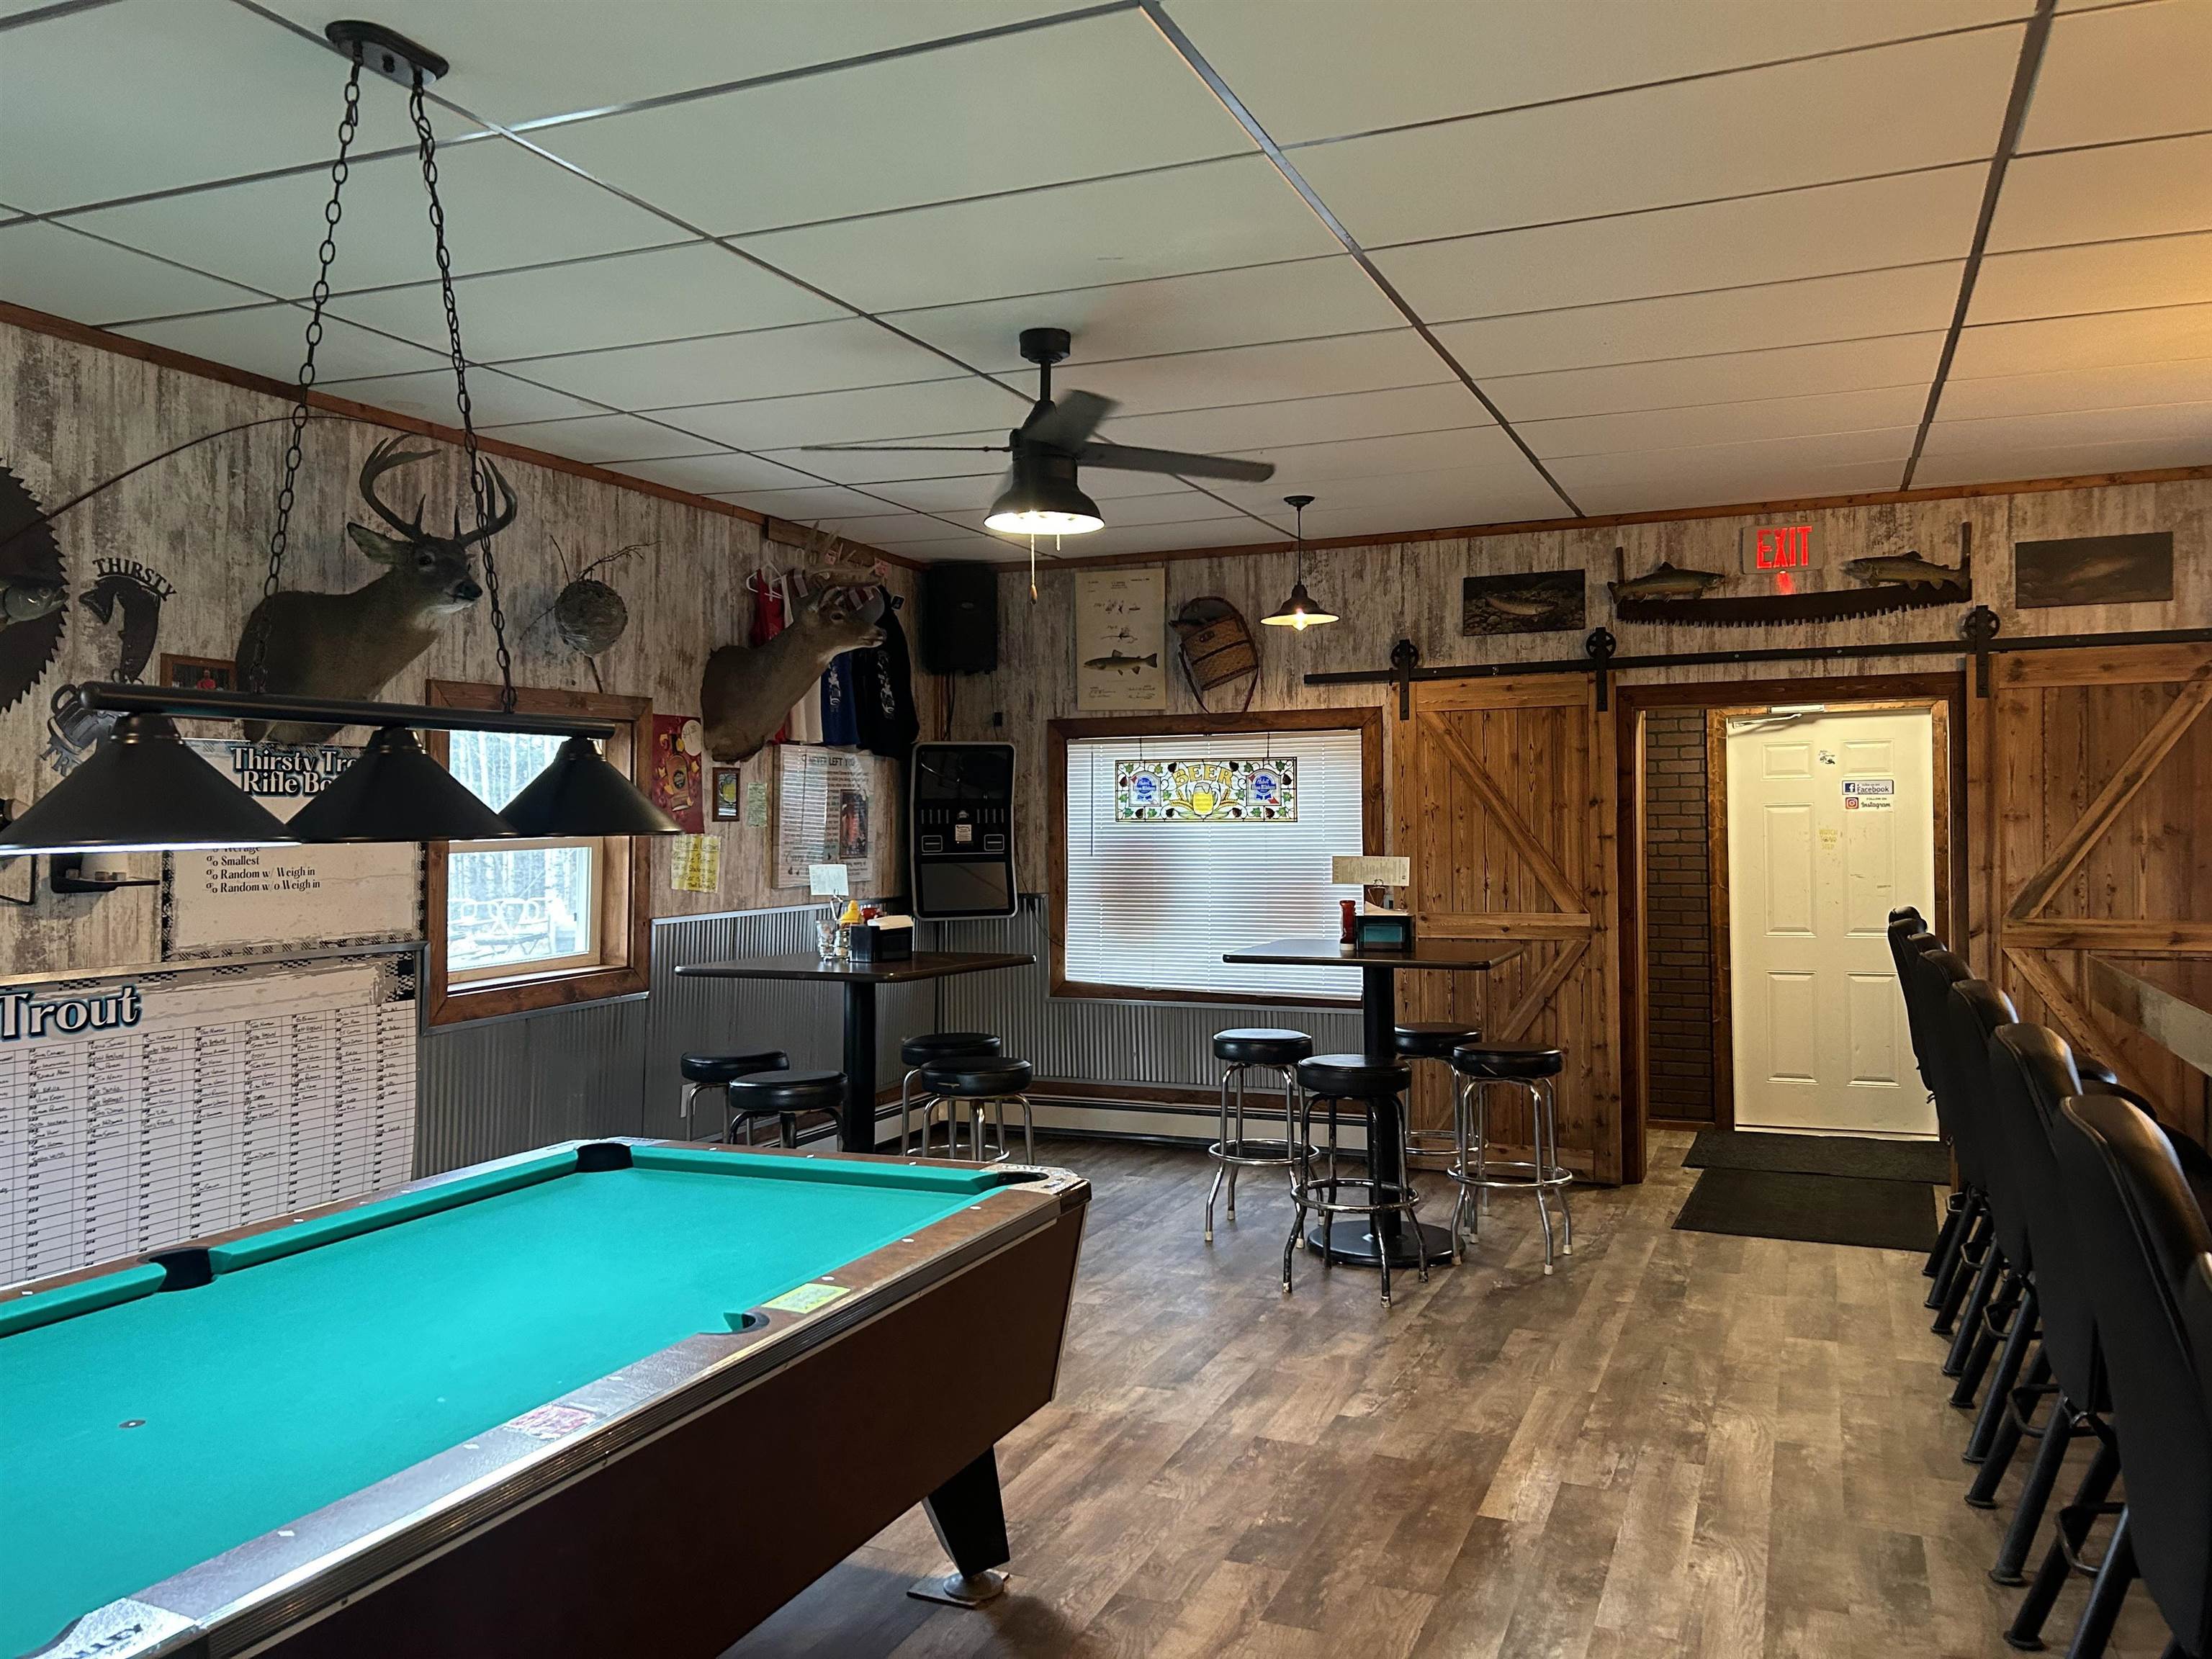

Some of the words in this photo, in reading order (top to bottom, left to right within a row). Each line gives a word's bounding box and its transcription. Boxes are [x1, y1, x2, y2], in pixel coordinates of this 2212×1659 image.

[1756, 526, 1812, 569] EXIT
[92, 557, 177, 601] THIRSTY
[829, 757, 842, 766] LEFT
[242, 770, 300, 793] Rifle
[1172, 764, 1234, 788] BEER
[221, 855, 260, 866] Smallest
[220, 868, 260, 879] Random
[276, 867, 305, 879] Weigh
[307, 867, 315, 876] in
[220, 881, 260, 893] Random
[282, 880, 311, 892] Weigh
[313, 880, 320, 889] in
[0, 987, 139, 1037] Trout
